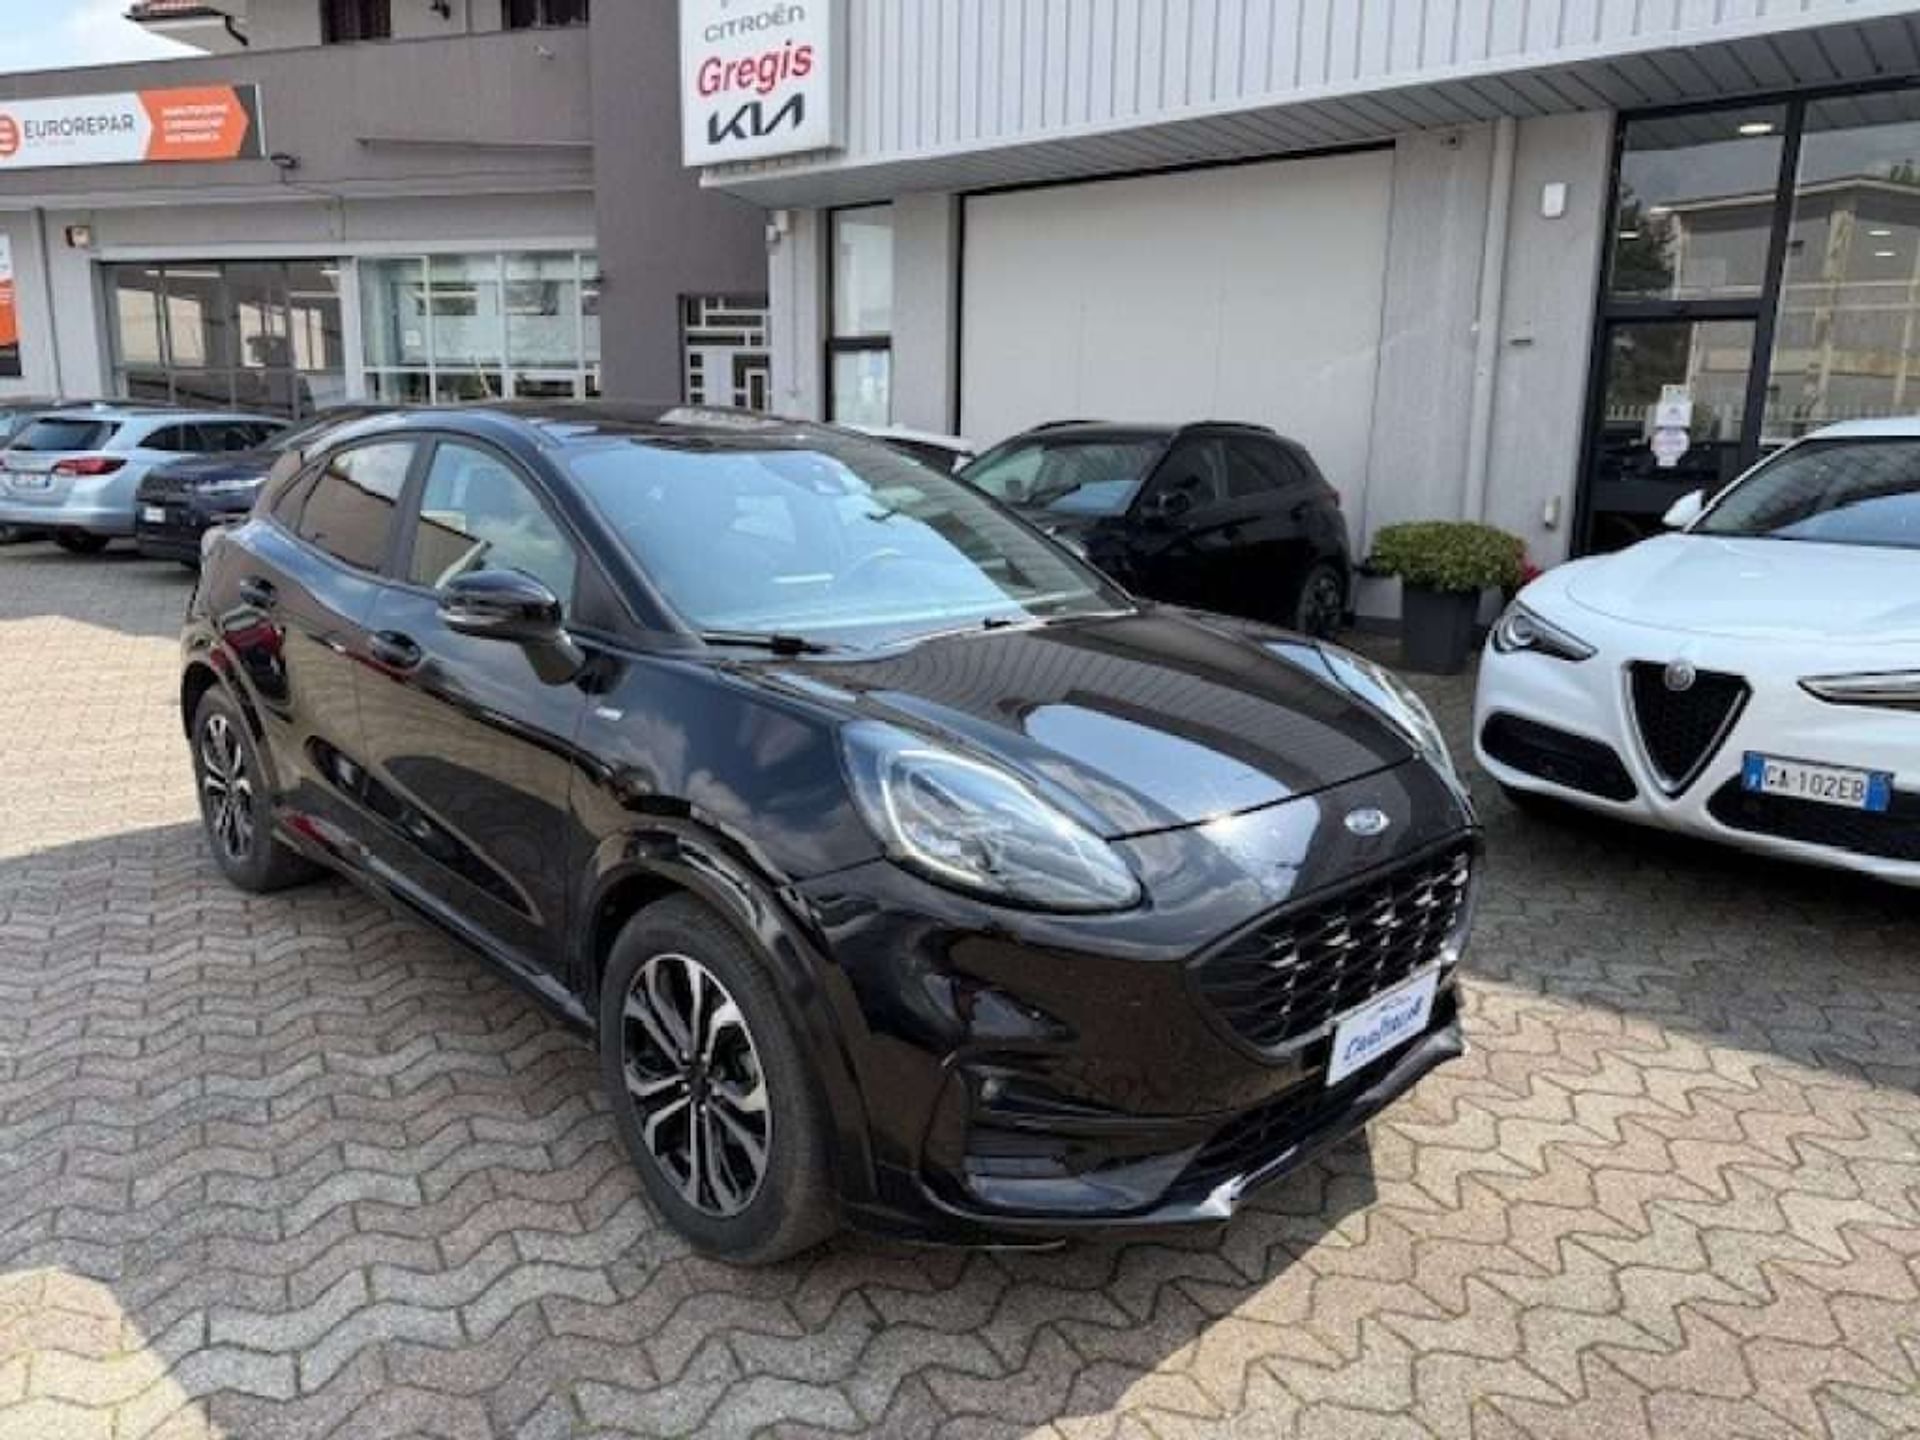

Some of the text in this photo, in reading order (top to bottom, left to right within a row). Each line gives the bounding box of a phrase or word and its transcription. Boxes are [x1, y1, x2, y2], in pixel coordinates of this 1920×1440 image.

[697, 39, 813, 96] Gregis
[24, 114, 136, 139] EUROREPAR
[707, 92, 805, 145] KIA
